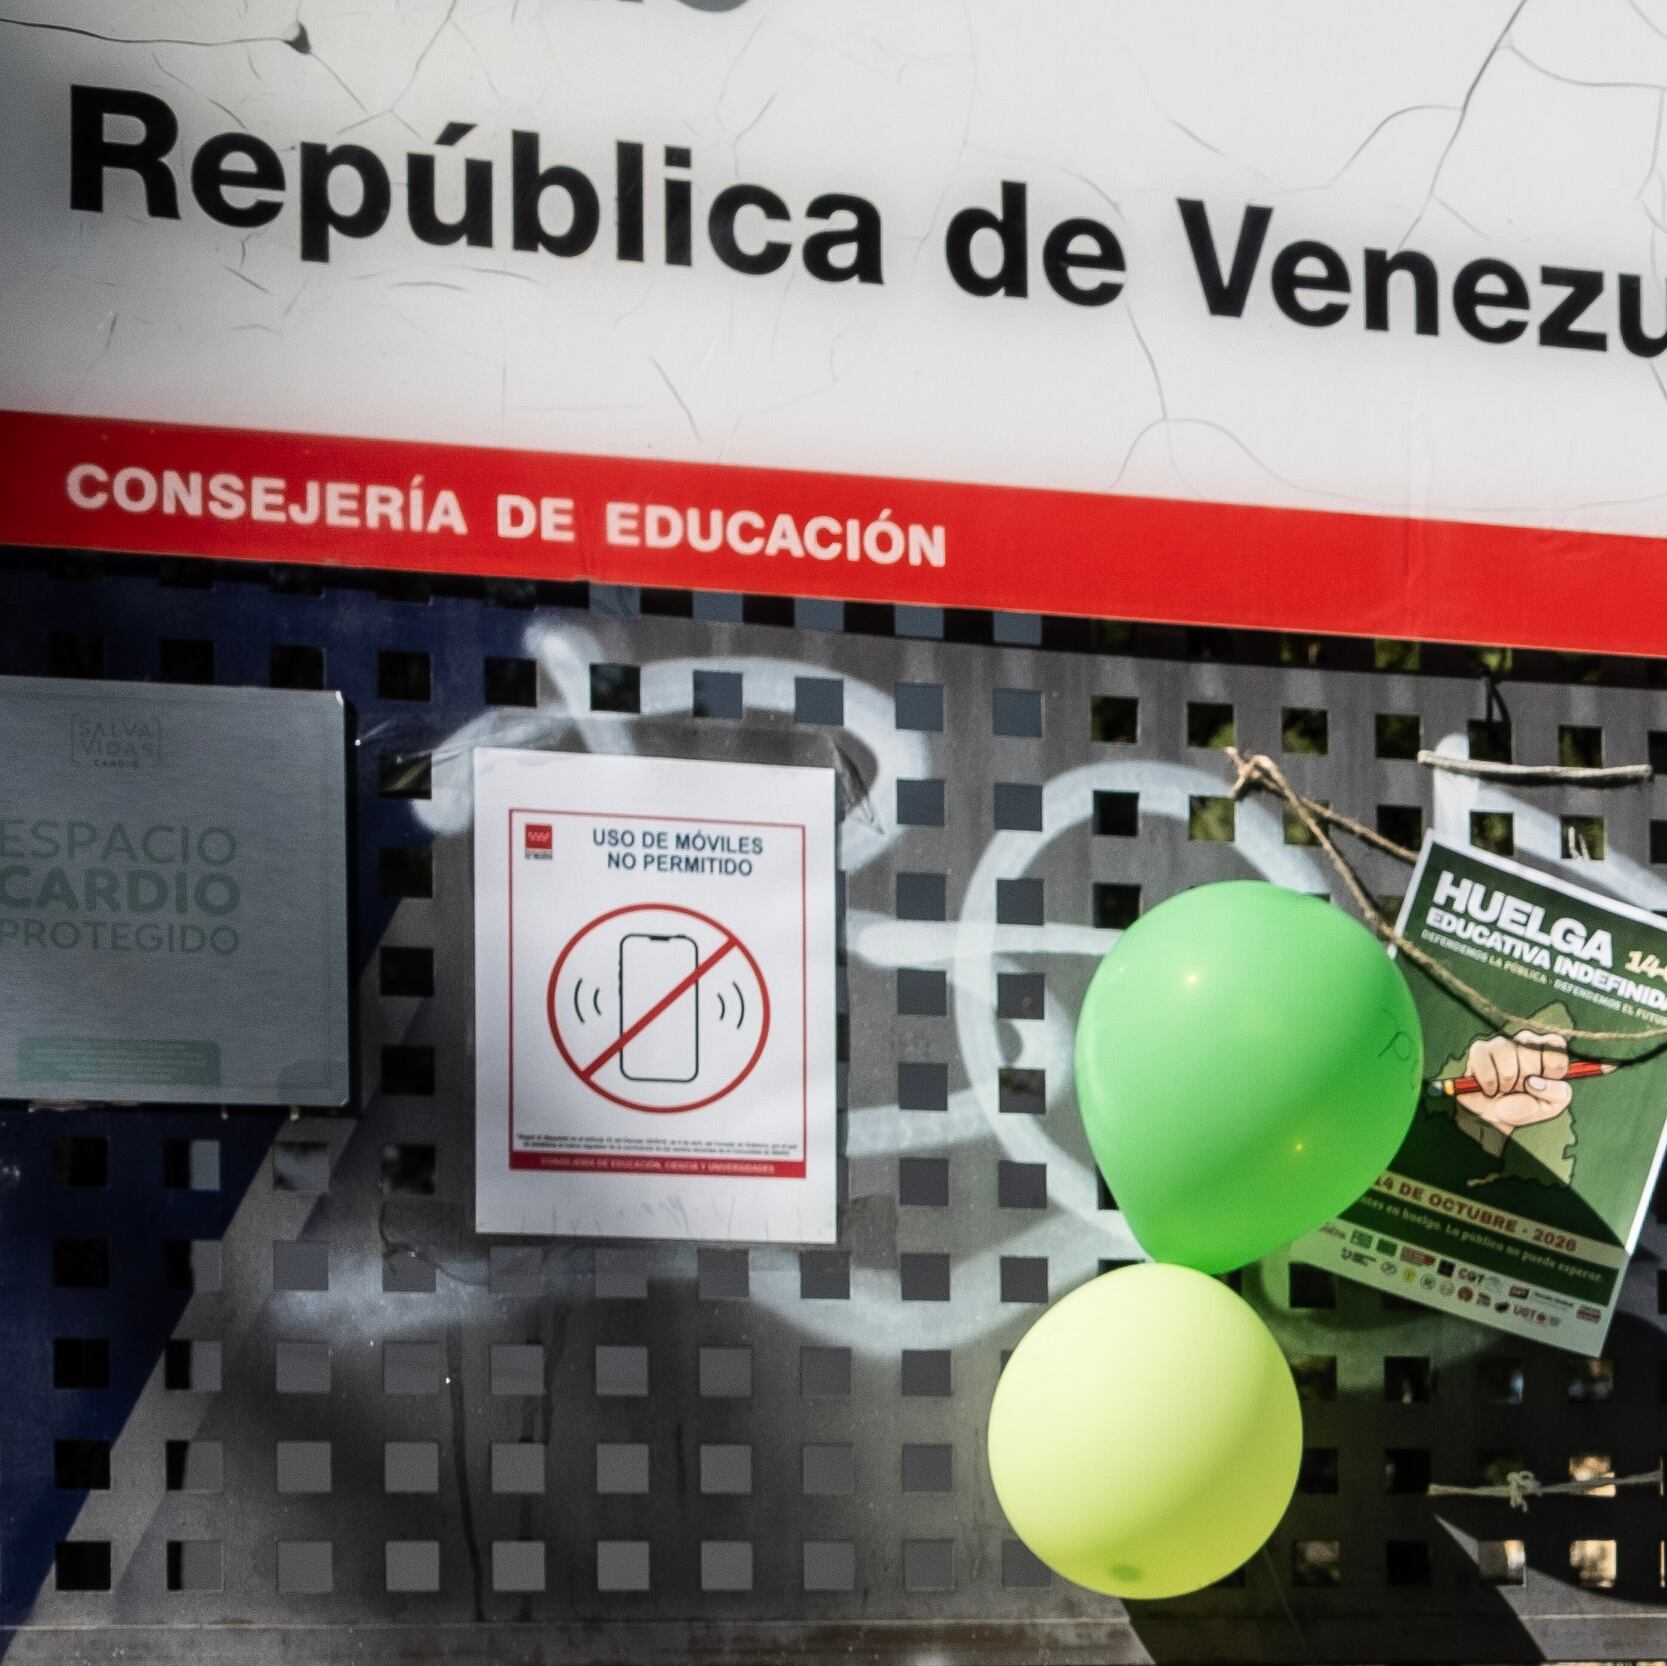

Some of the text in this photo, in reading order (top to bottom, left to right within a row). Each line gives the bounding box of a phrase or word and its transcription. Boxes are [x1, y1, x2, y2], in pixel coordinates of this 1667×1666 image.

[69, 84, 885, 285] República
[945, 181, 1128, 308] de
[65, 462, 946, 568] CONSEJERÍA DE EDUCACIÓN
[0, 819, 238, 866] ESPACIO
[593, 829, 763, 855] USO DE MÓVILES
[607, 853, 752, 876] NO PERMITIDO
[0, 864, 241, 916] CARDIO
[1431, 869, 1614, 969] HUELGA
[0, 917, 240, 955] PROTEGIDO
[1423, 904, 1555, 972] EDUCATIVA
[1398, 1181, 1423, 1202] DE
[1427, 1191, 1519, 1234] OCTUBRE
[1532, 1225, 1579, 1253] 2026
